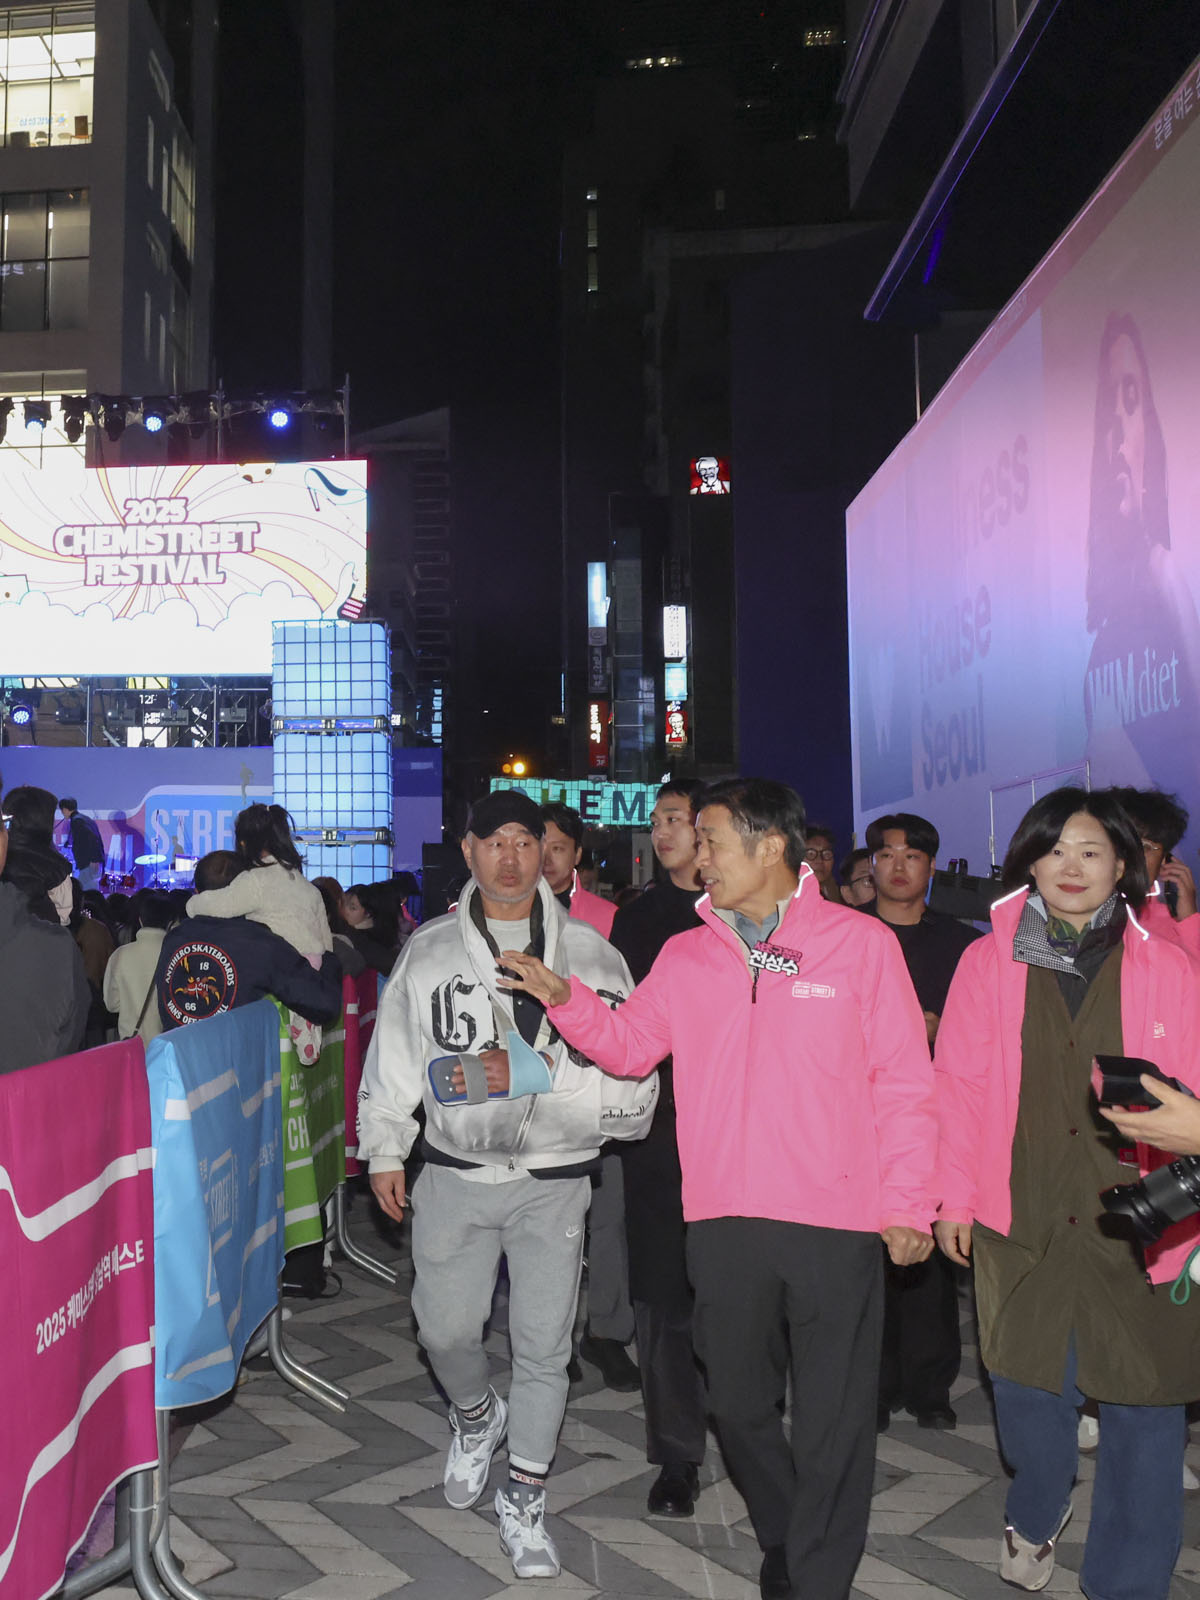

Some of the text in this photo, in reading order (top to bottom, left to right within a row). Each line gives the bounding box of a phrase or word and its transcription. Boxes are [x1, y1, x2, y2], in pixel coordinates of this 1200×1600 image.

[124, 497, 189, 524] 2025
[53, 521, 261, 556] CHEMISTREET
[84, 553, 227, 586] FESTIVAL
[1138, 645, 1182, 718] diet
[921, 674, 988, 792] Seoul
[150, 809, 236, 856] STRE
[165, 944, 235, 987] ANTIHERO SKATEBOARDS
[199, 961, 210, 971] 18
[748, 949, 799, 977] 전성수
[167, 1000, 184, 1020] VANS
[184, 1002, 198, 1012] 66
[35, 1305, 67, 1356] 2025
